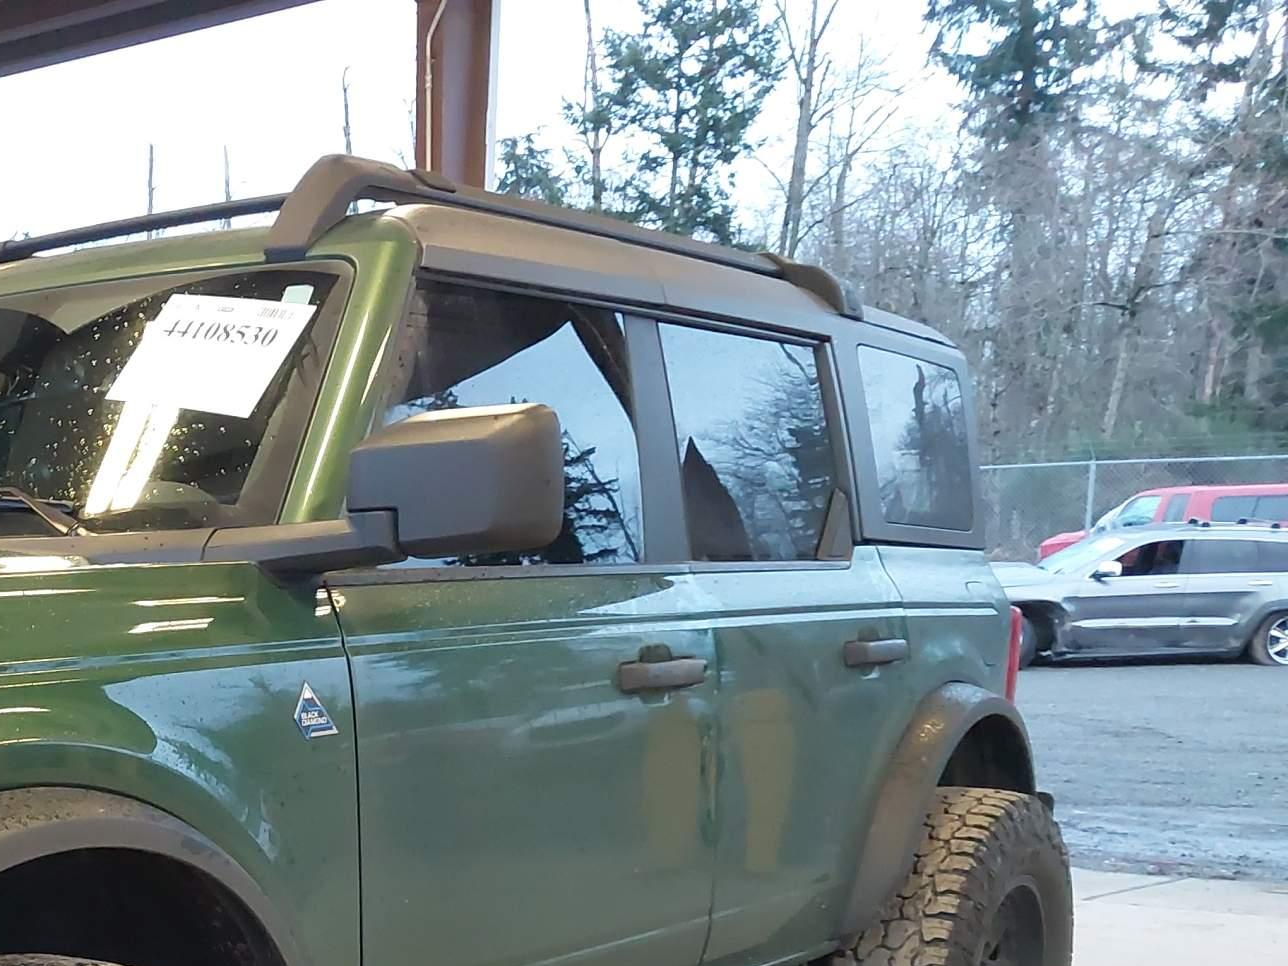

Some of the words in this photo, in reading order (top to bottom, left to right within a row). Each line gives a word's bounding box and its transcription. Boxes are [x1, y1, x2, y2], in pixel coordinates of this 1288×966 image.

[163, 319, 279, 346] 44108530
[300, 711, 319, 719] BLACK
[301, 717, 328, 726] DIAMOND
